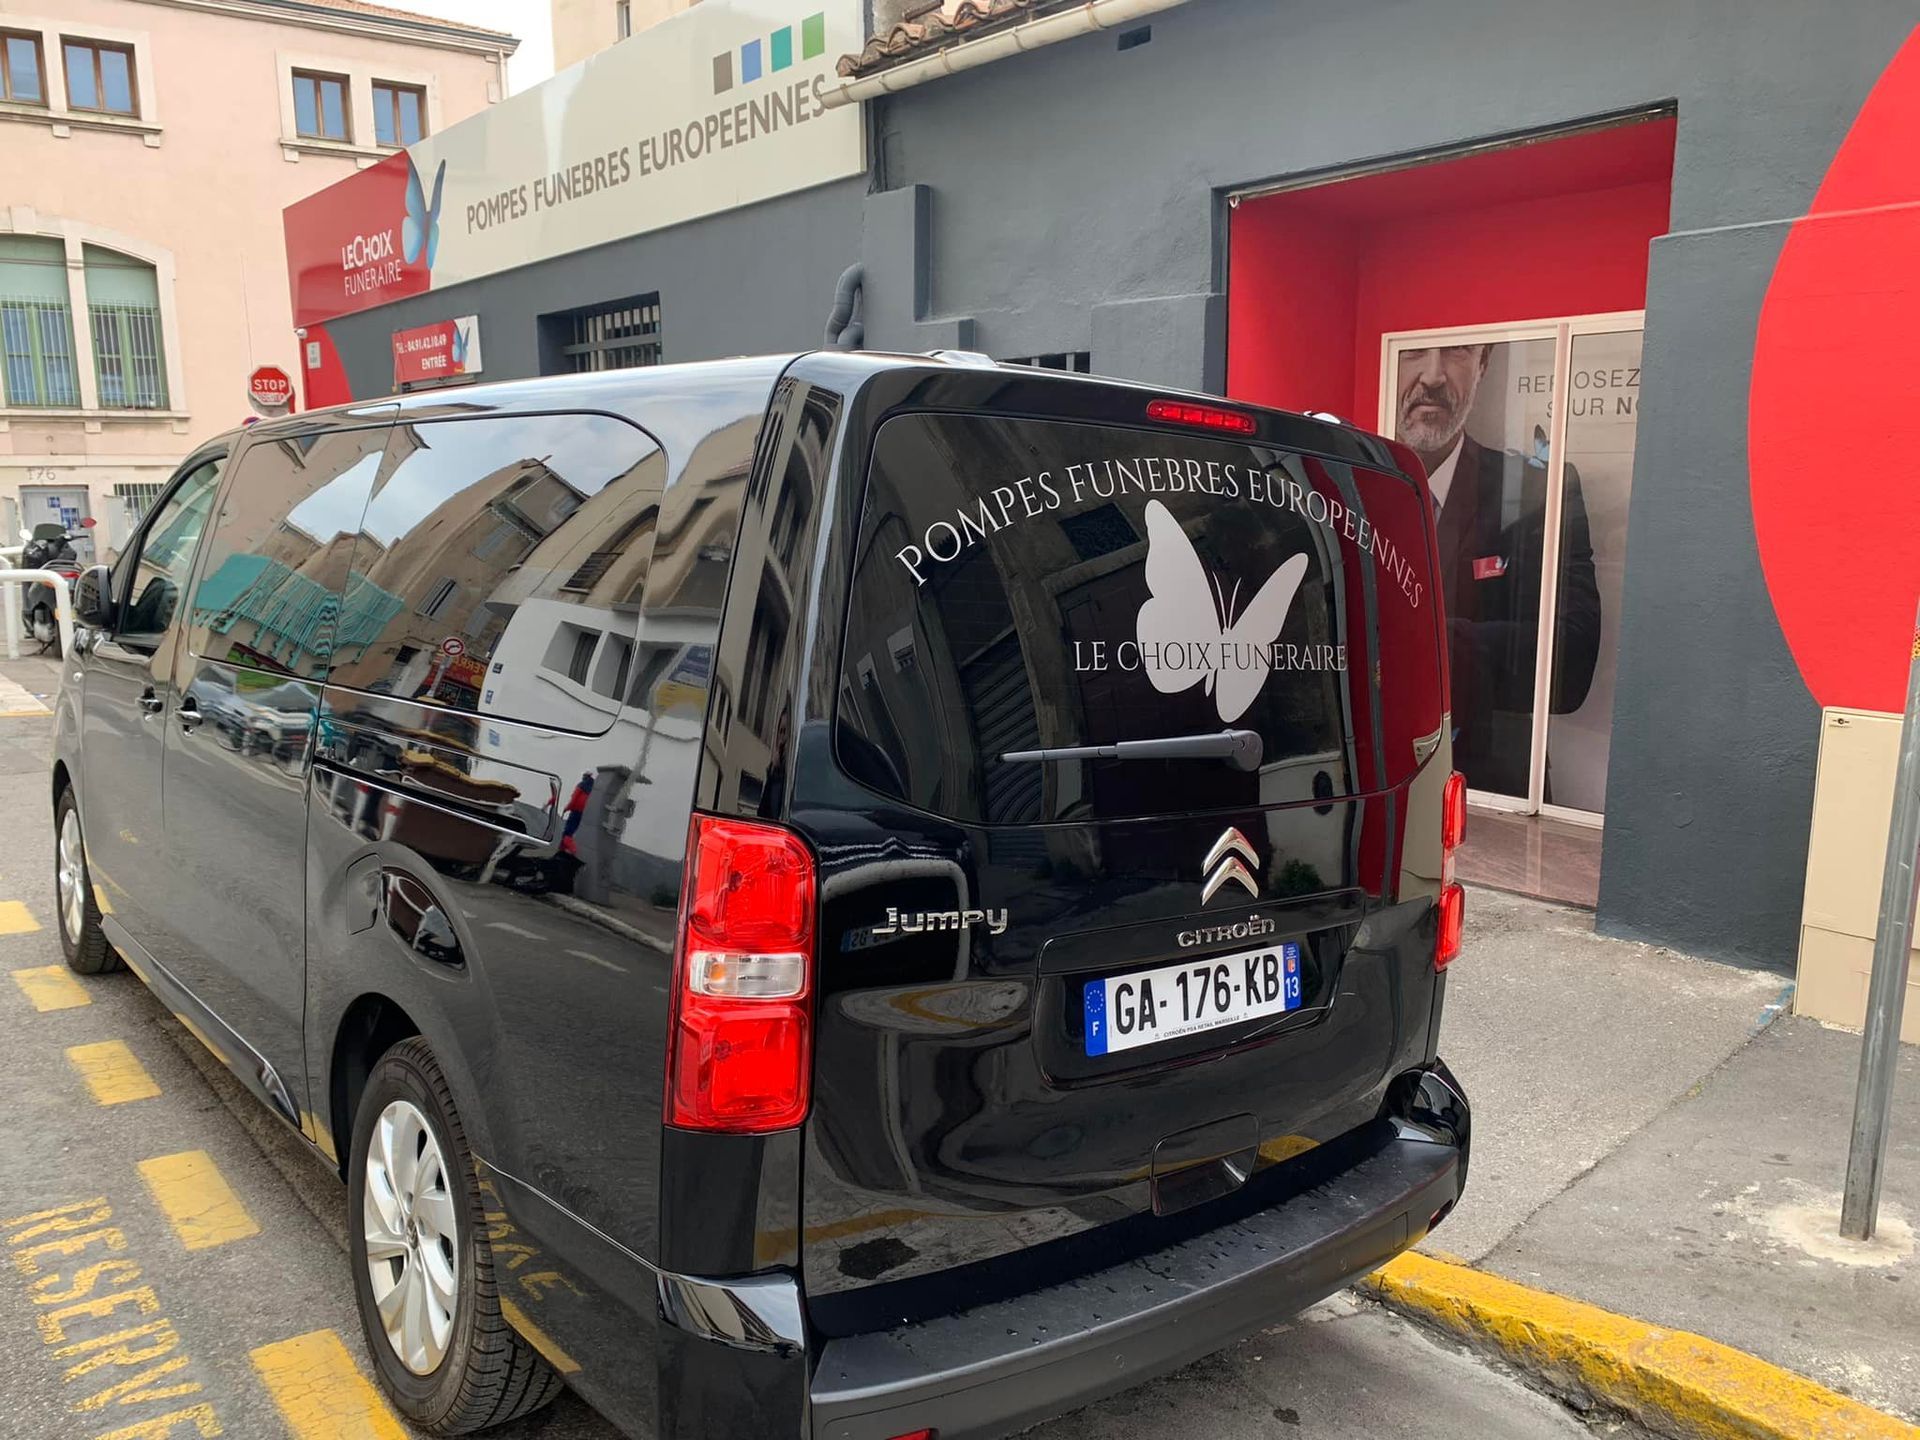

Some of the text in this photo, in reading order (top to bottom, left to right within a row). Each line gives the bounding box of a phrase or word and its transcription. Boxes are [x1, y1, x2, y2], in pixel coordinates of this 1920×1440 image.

[466, 73, 826, 234] POMPES FUNEBRES EUROPEENNES
[344, 259, 402, 296] FUNERAIRE
[421, 352, 447, 370] ENTRÉE
[254, 379, 286, 391] STOP
[1616, 396, 1639, 415] N
[895, 458, 1423, 609] POMPES FUNEBRES EUROPEENNES
[1073, 640, 1348, 672] LE CHOIX FUNERAIRE
[872, 907, 1009, 935] Jumpy
[1285, 976, 1299, 998] 13
[1092, 1021, 1100, 1036] F
[2, 1196, 224, 1440] RESERVE
